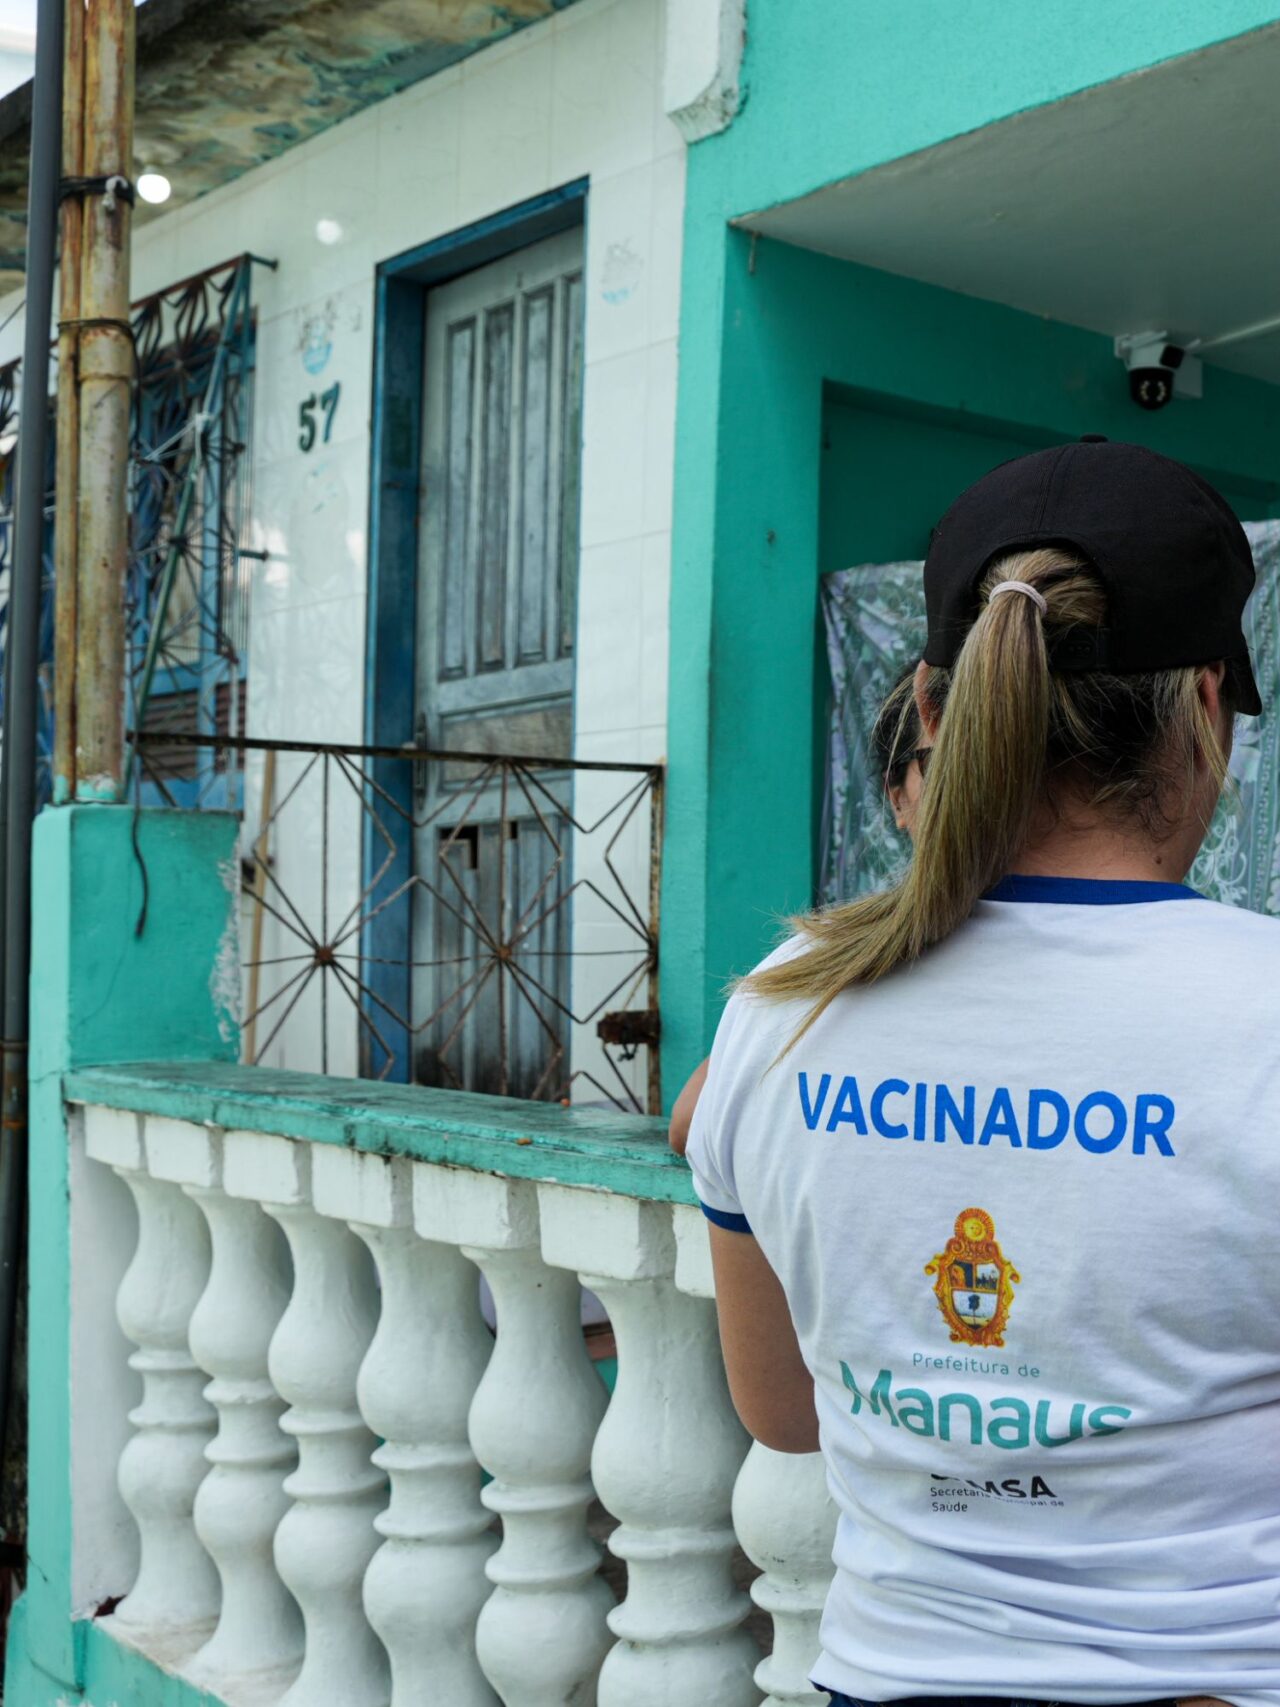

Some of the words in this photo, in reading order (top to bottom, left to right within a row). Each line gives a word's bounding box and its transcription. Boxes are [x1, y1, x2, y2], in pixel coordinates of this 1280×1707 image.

[298, 381, 340, 453] 57
[798, 1072, 1176, 1157] VACINADOR
[912, 1352, 1009, 1376] Prefeitura
[1017, 1363, 1040, 1378] de
[838, 1360, 1132, 1450] Manaus
